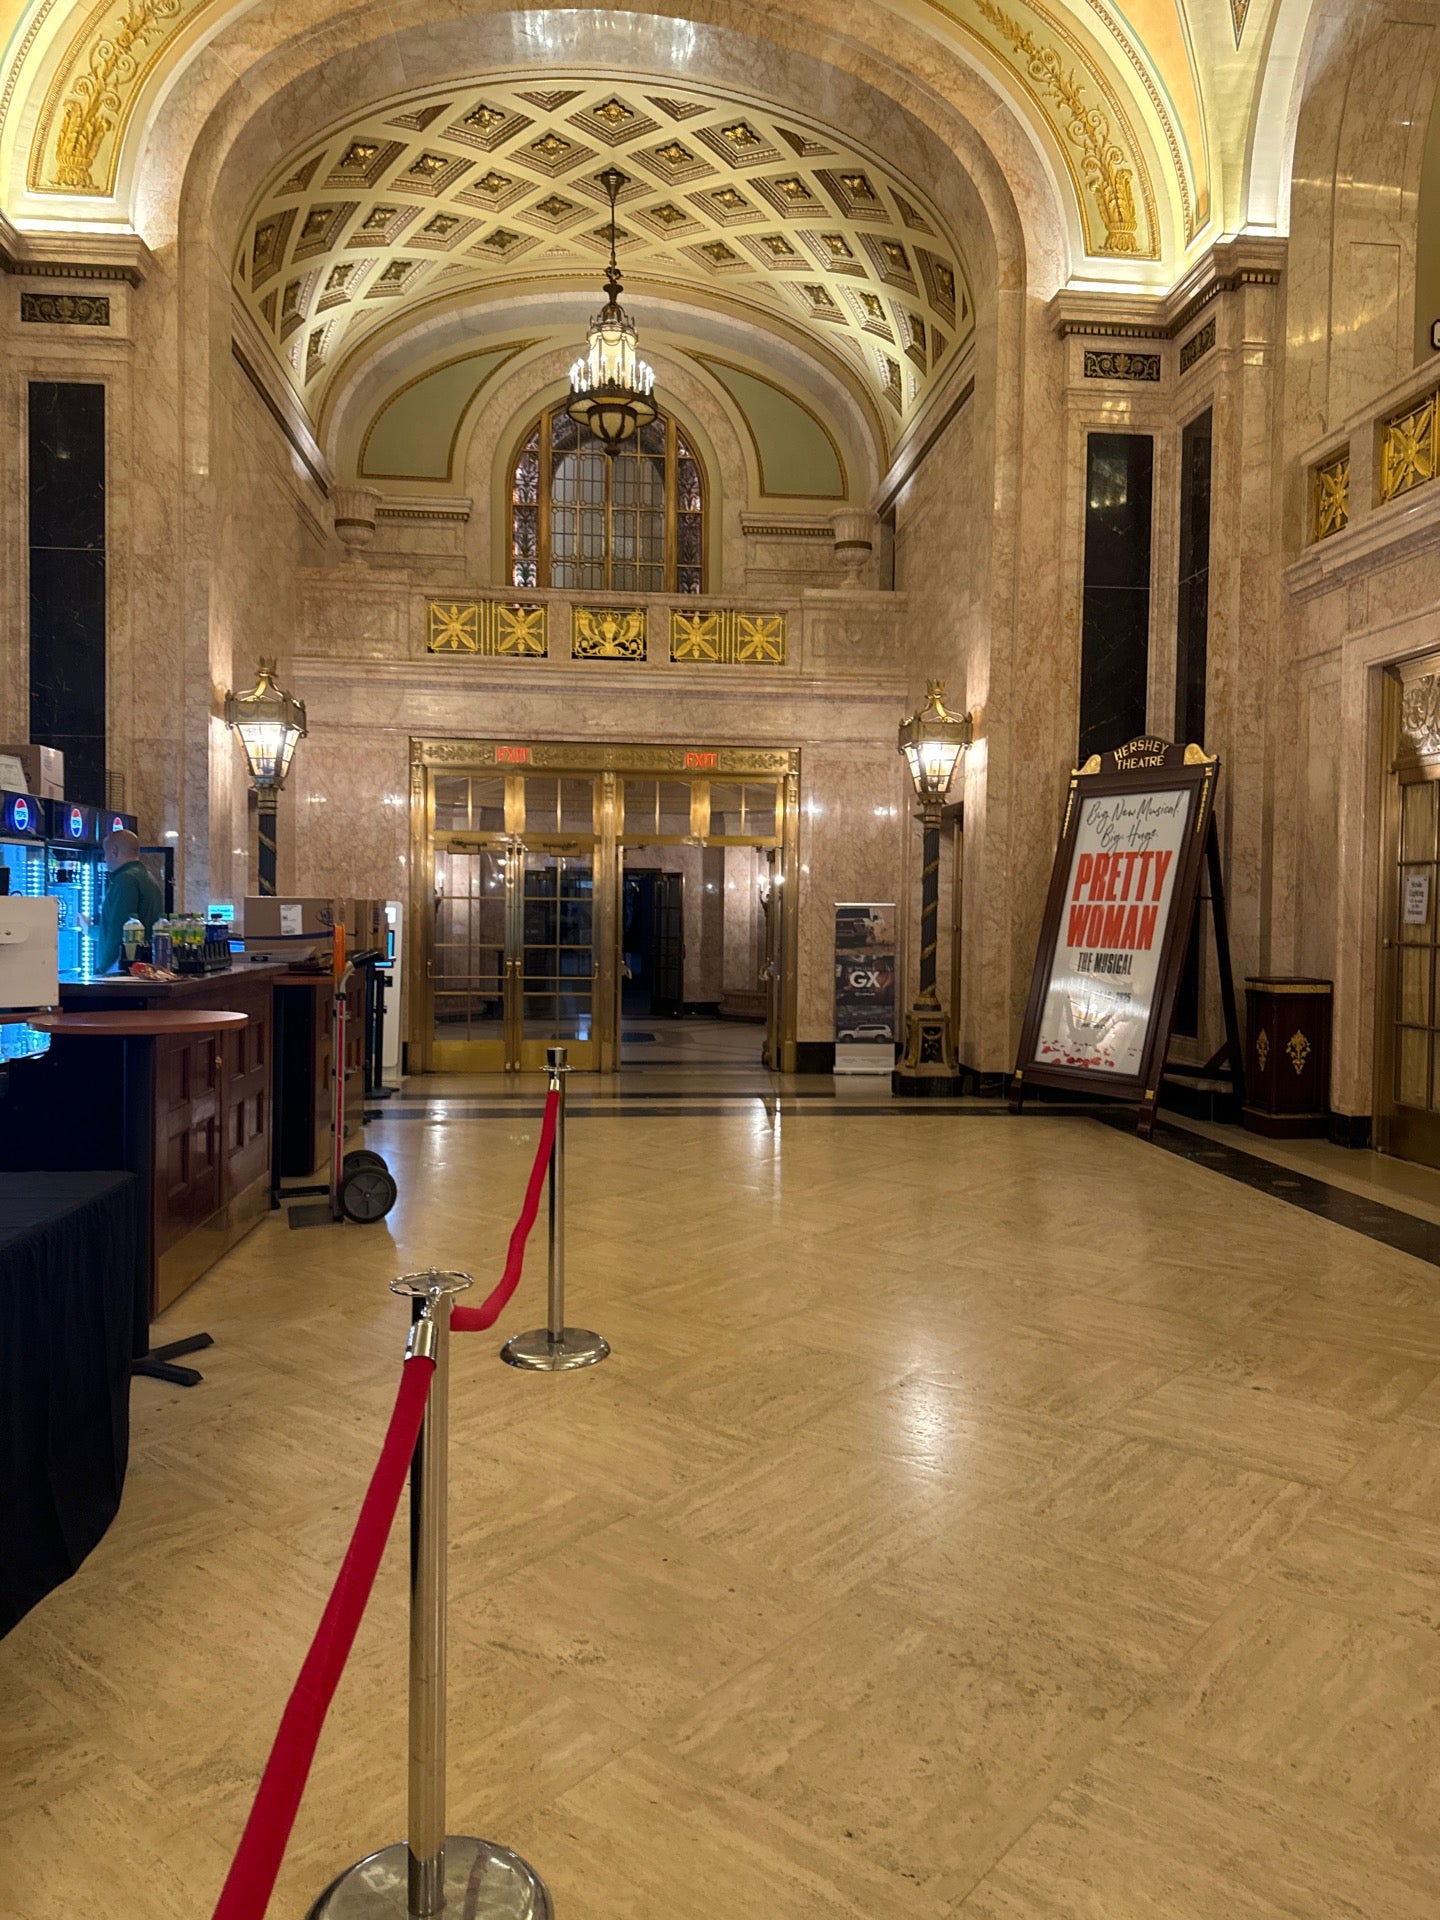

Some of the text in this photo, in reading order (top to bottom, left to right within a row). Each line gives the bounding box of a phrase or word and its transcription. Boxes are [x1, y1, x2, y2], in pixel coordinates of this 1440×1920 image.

[497, 746, 528, 763] EXIT
[686, 752, 717, 768] EXIT
[1113, 739, 1169, 761] HERSHEY
[1116, 754, 1166, 770] THEATRE
[1111, 798, 1136, 822] New
[1071, 850, 1173, 901] PRETTY
[1066, 904, 1159, 951] WOMAN
[1077, 952, 1133, 976] THE MUSICAL
[850, 971, 880, 988] GX
